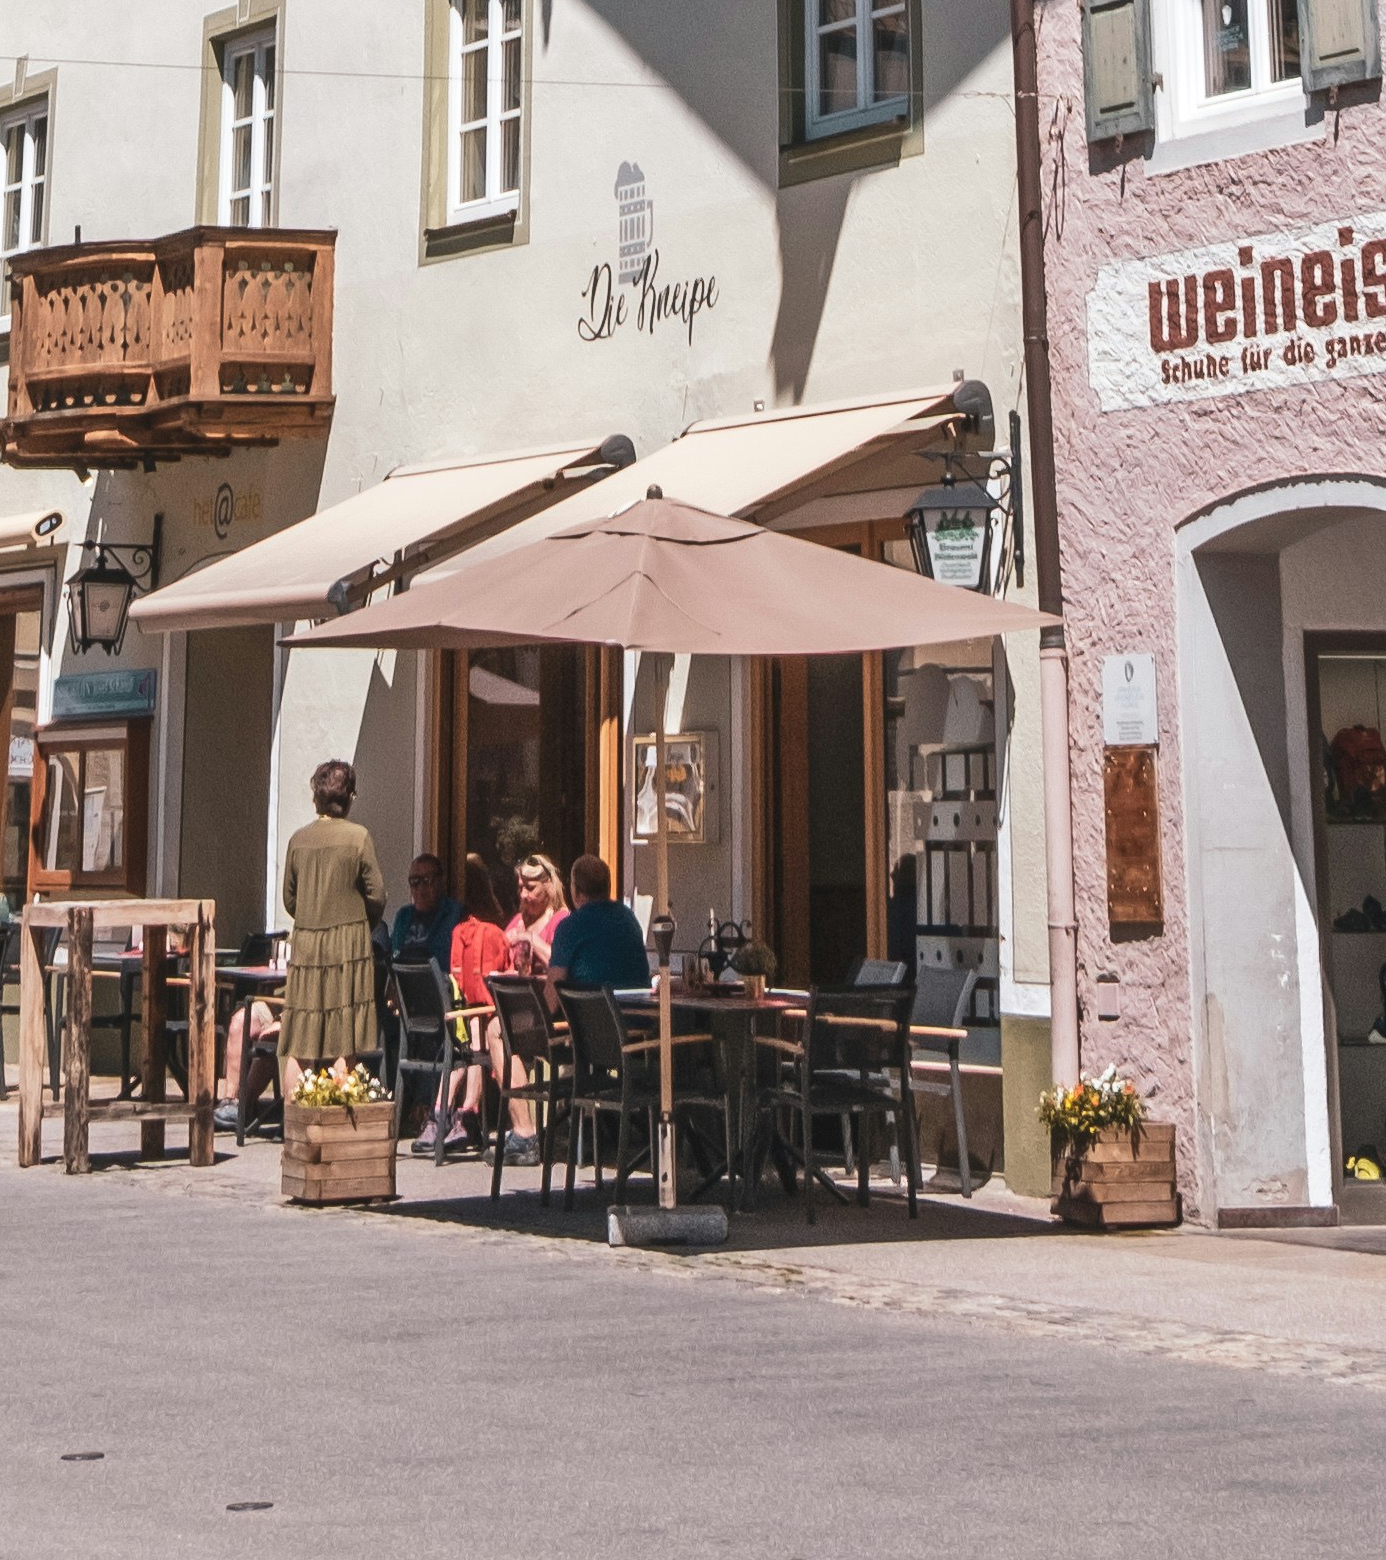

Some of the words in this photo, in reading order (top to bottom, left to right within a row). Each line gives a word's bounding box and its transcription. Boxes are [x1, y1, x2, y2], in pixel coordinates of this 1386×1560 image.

[578, 262, 629, 342] Die
[632, 248, 720, 347] Kneipe
[1161, 353, 1230, 385] Schuhe
[1240, 342, 1273, 375] für
[1283, 338, 1315, 368] die
[1325, 331, 1386, 370] ganze
